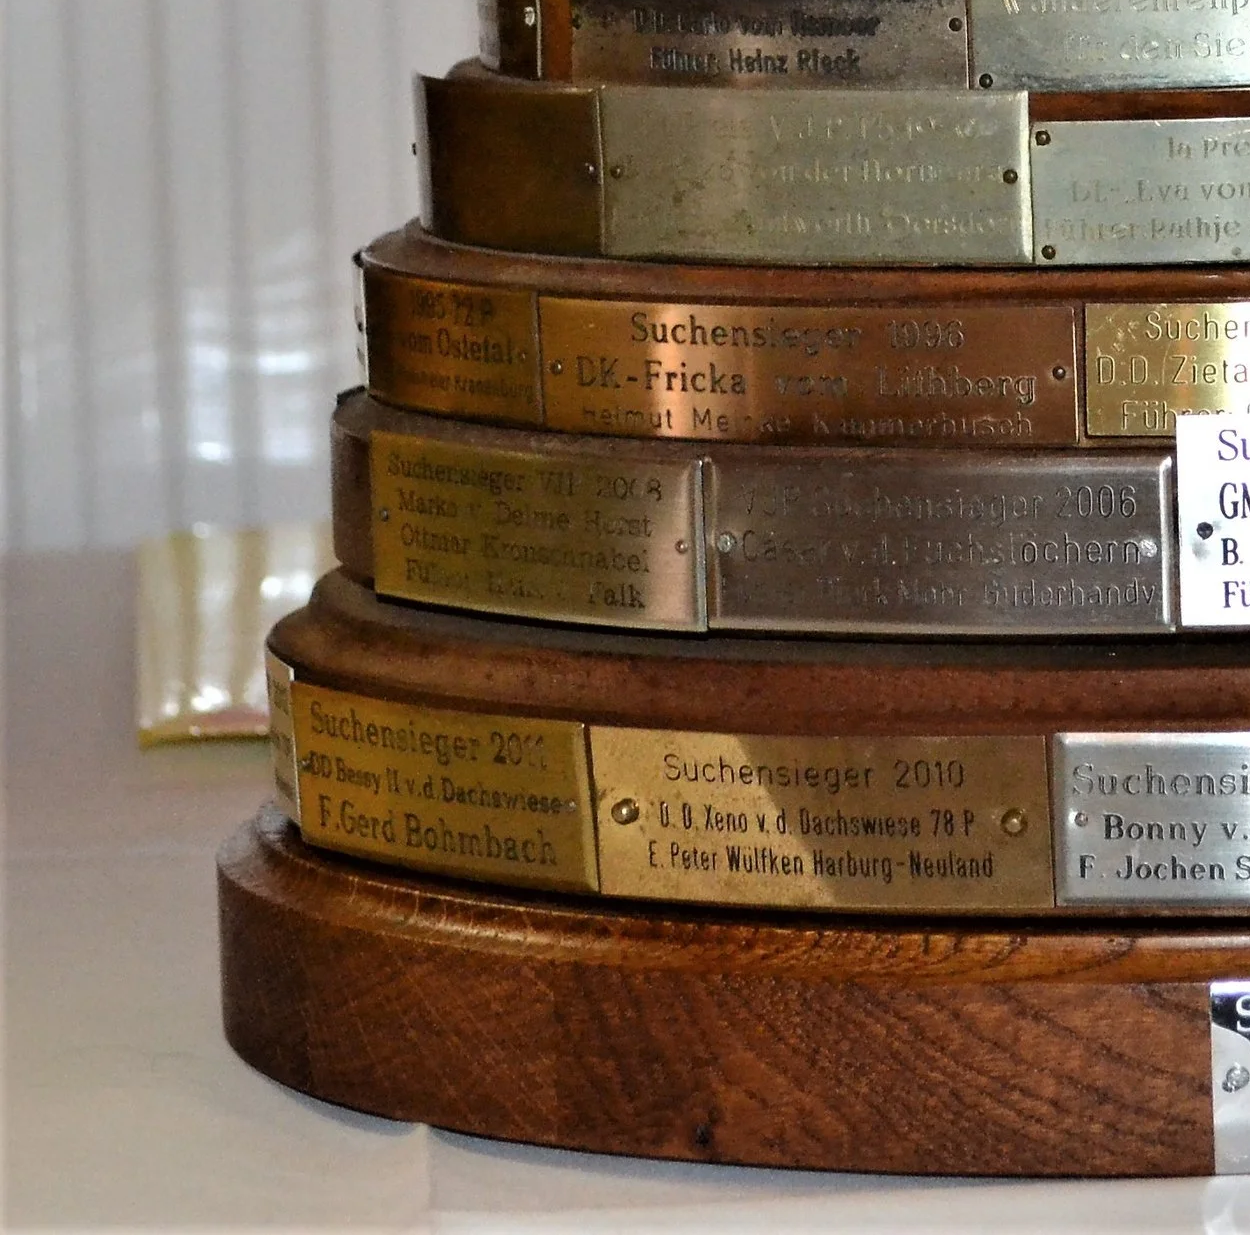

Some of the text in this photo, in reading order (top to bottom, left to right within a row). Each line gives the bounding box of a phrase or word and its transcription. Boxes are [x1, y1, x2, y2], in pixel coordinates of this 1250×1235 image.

[631, 312, 863, 356] Suchensieger
[576, 355, 747, 395] DK-Fricka
[1169, 354, 1249, 385] Zieta
[1055, 484, 1137, 519] 2006
[310, 700, 479, 767] Suchensieger
[662, 753, 965, 792] Suchensieger 2010
[703, 802, 749, 834] Xeno
[800, 807, 922, 838] Dachswiese
[930, 808, 954, 836] 78
[963, 809, 975, 836] P
[1103, 812, 1208, 847] Bonny
[670, 842, 718, 872] Peter
[725, 846, 804, 877] Wülfken
[1115, 853, 1226, 882] Jochen
